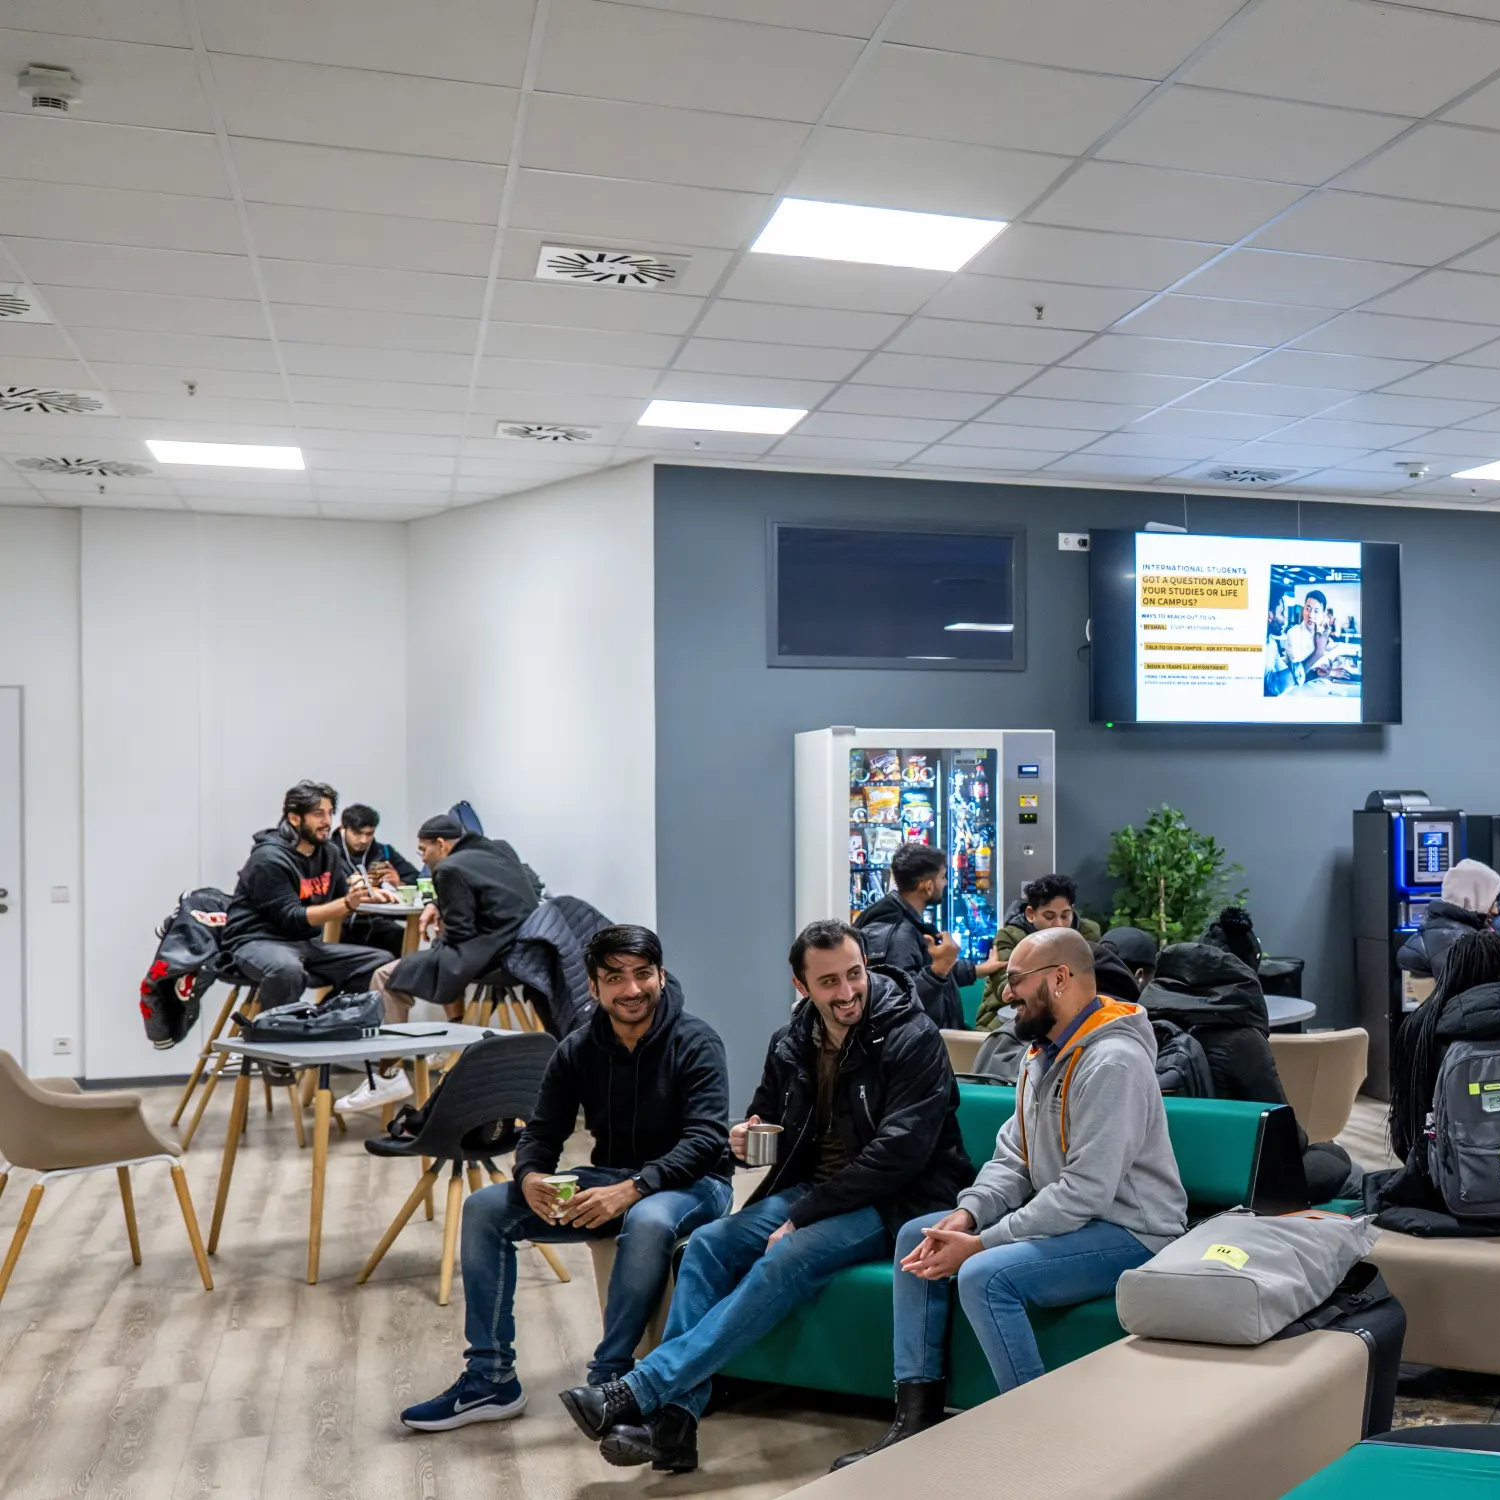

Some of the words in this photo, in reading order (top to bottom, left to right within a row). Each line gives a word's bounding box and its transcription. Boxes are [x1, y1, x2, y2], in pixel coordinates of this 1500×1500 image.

[1142, 564, 1204, 573] INTERNATIONAL
[1206, 566, 1247, 574] STUDENTS
[1142, 576, 1160, 584] GOT
[1162, 576, 1168, 584] A
[1169, 577, 1214, 585] QUESTION
[1215, 578, 1245, 586] ABOUT
[1142, 586, 1167, 595] YOUR
[1168, 587, 1205, 596] STUDIES
[1206, 588, 1218, 596] OR
[1220, 589, 1238, 597] LIFE
[1142, 597, 1155, 605] ON
[1157, 598, 1198, 606] CAMPUS?
[1217, 1246, 1231, 1254] iu
